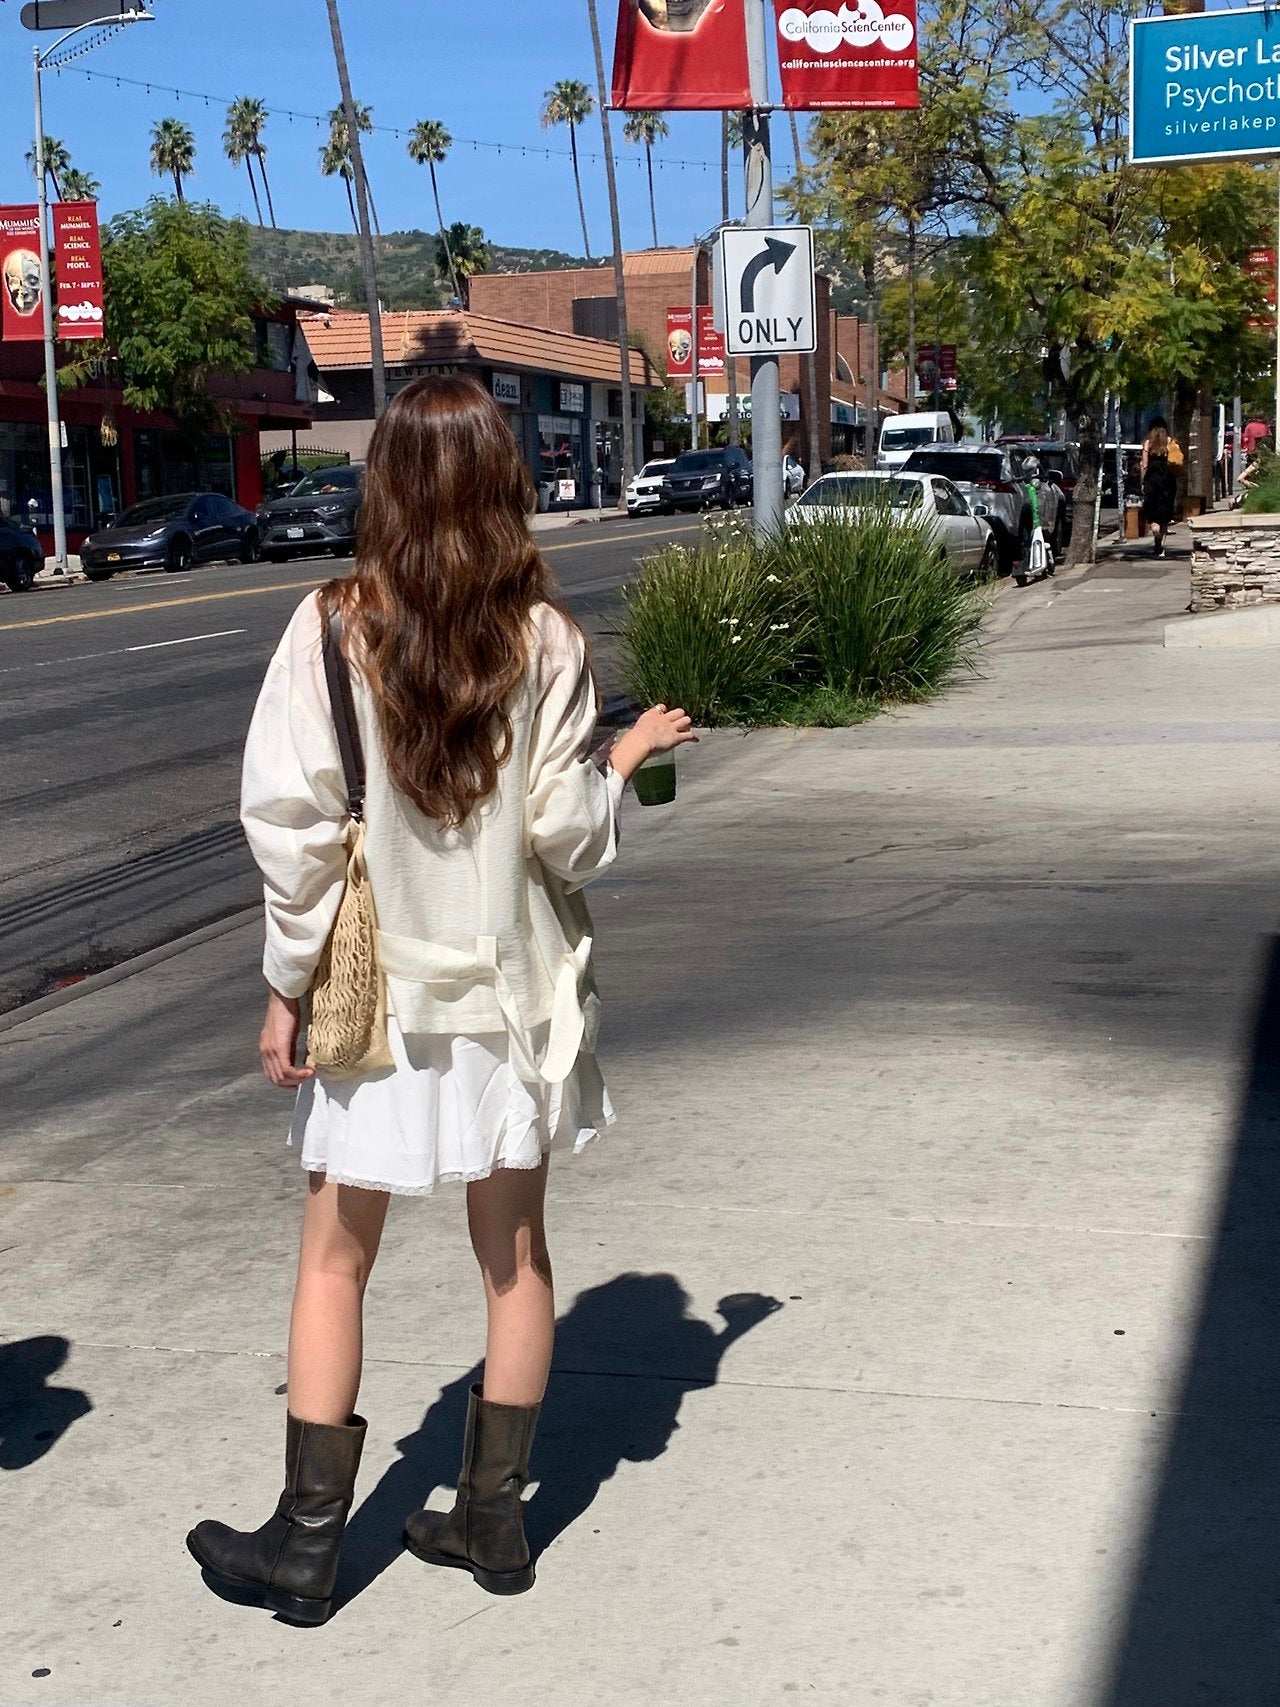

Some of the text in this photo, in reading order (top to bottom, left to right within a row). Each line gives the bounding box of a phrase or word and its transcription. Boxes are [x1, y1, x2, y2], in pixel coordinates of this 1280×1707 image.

[782, 59, 915, 69] californiasciencecenter.org
[1165, 44, 1249, 72] Silver
[1165, 73, 1280, 112] Psychot
[1165, 115, 1280, 136] silverlakep
[738, 316, 803, 344] ONLY
